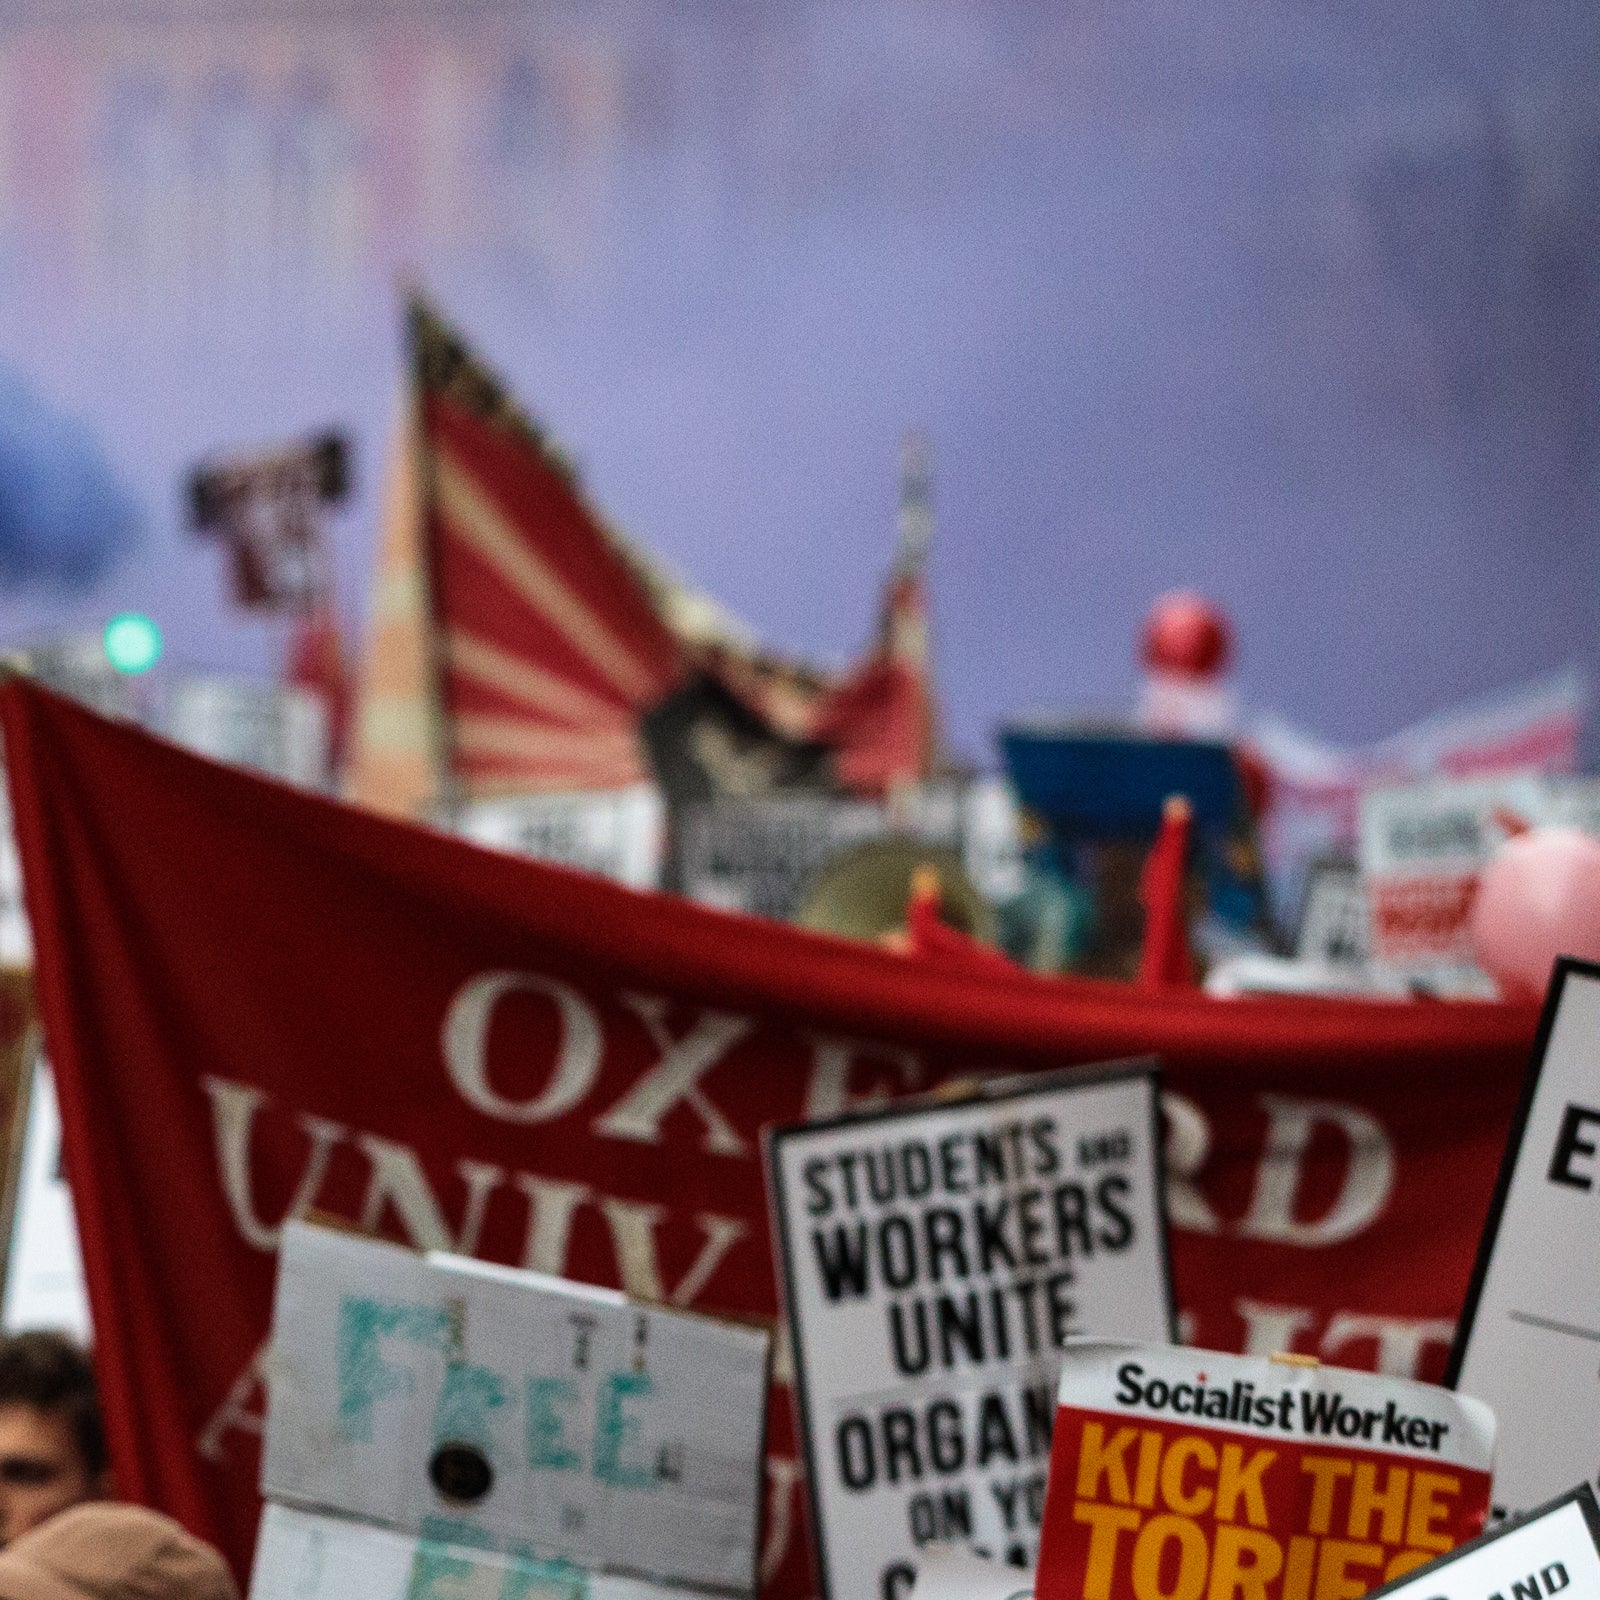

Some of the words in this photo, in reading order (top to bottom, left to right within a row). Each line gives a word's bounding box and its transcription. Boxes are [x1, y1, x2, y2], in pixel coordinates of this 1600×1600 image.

[803, 1117, 1064, 1217] STUDENTS
[1075, 1127, 1133, 1172] AND
[809, 1176, 1134, 1306] WORKERS
[891, 1273, 1080, 1380] UNITE
[836, 1390, 1050, 1494] ORGAN
[1075, 1421, 1278, 1529] KICK
[1301, 1456, 1463, 1552] THE
[910, 1489, 973, 1549] ON
